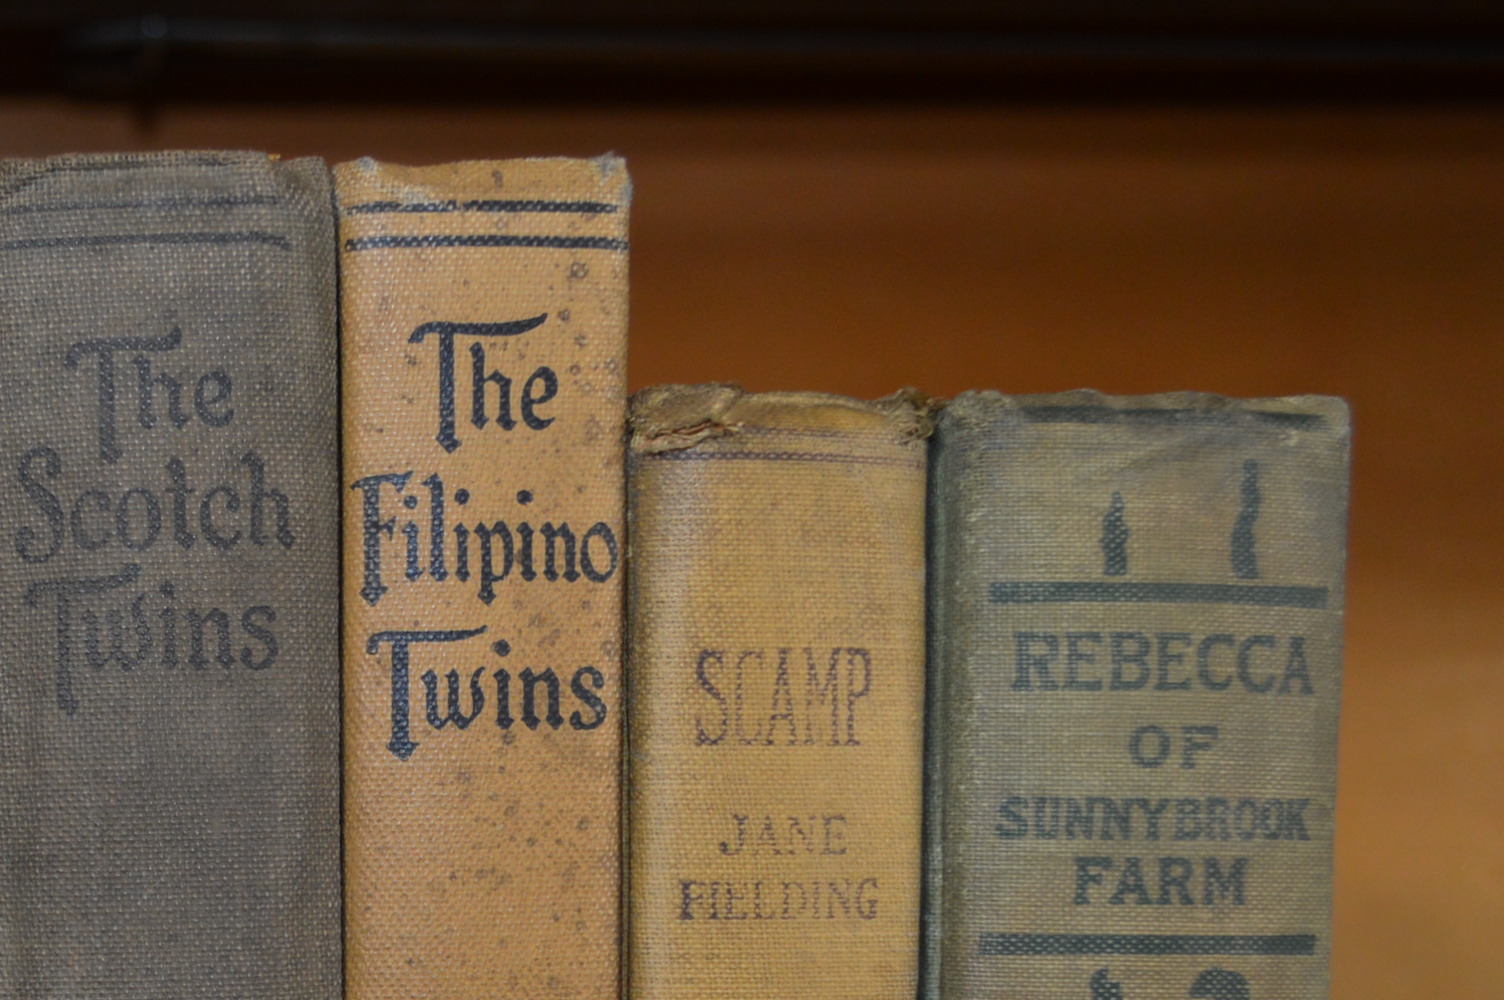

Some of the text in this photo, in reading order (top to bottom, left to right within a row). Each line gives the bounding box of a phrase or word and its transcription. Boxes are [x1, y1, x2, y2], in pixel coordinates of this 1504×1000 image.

[65, 326, 237, 464] The
[408, 312, 559, 454] The
[14, 446, 298, 564] Scotch
[351, 470, 621, 606] Filipino
[27, 562, 280, 716] Twins
[1011, 631, 1314, 696] REBECCA
[366, 625, 609, 762] Twins
[694, 647, 874, 747] SCAMP
[1128, 724, 1219, 769] OF
[718, 813, 848, 856] JANE
[996, 797, 1312, 842] SUNNYBROOK
[678, 878, 880, 921] FIELDING
[1073, 855, 1249, 906] FARM
